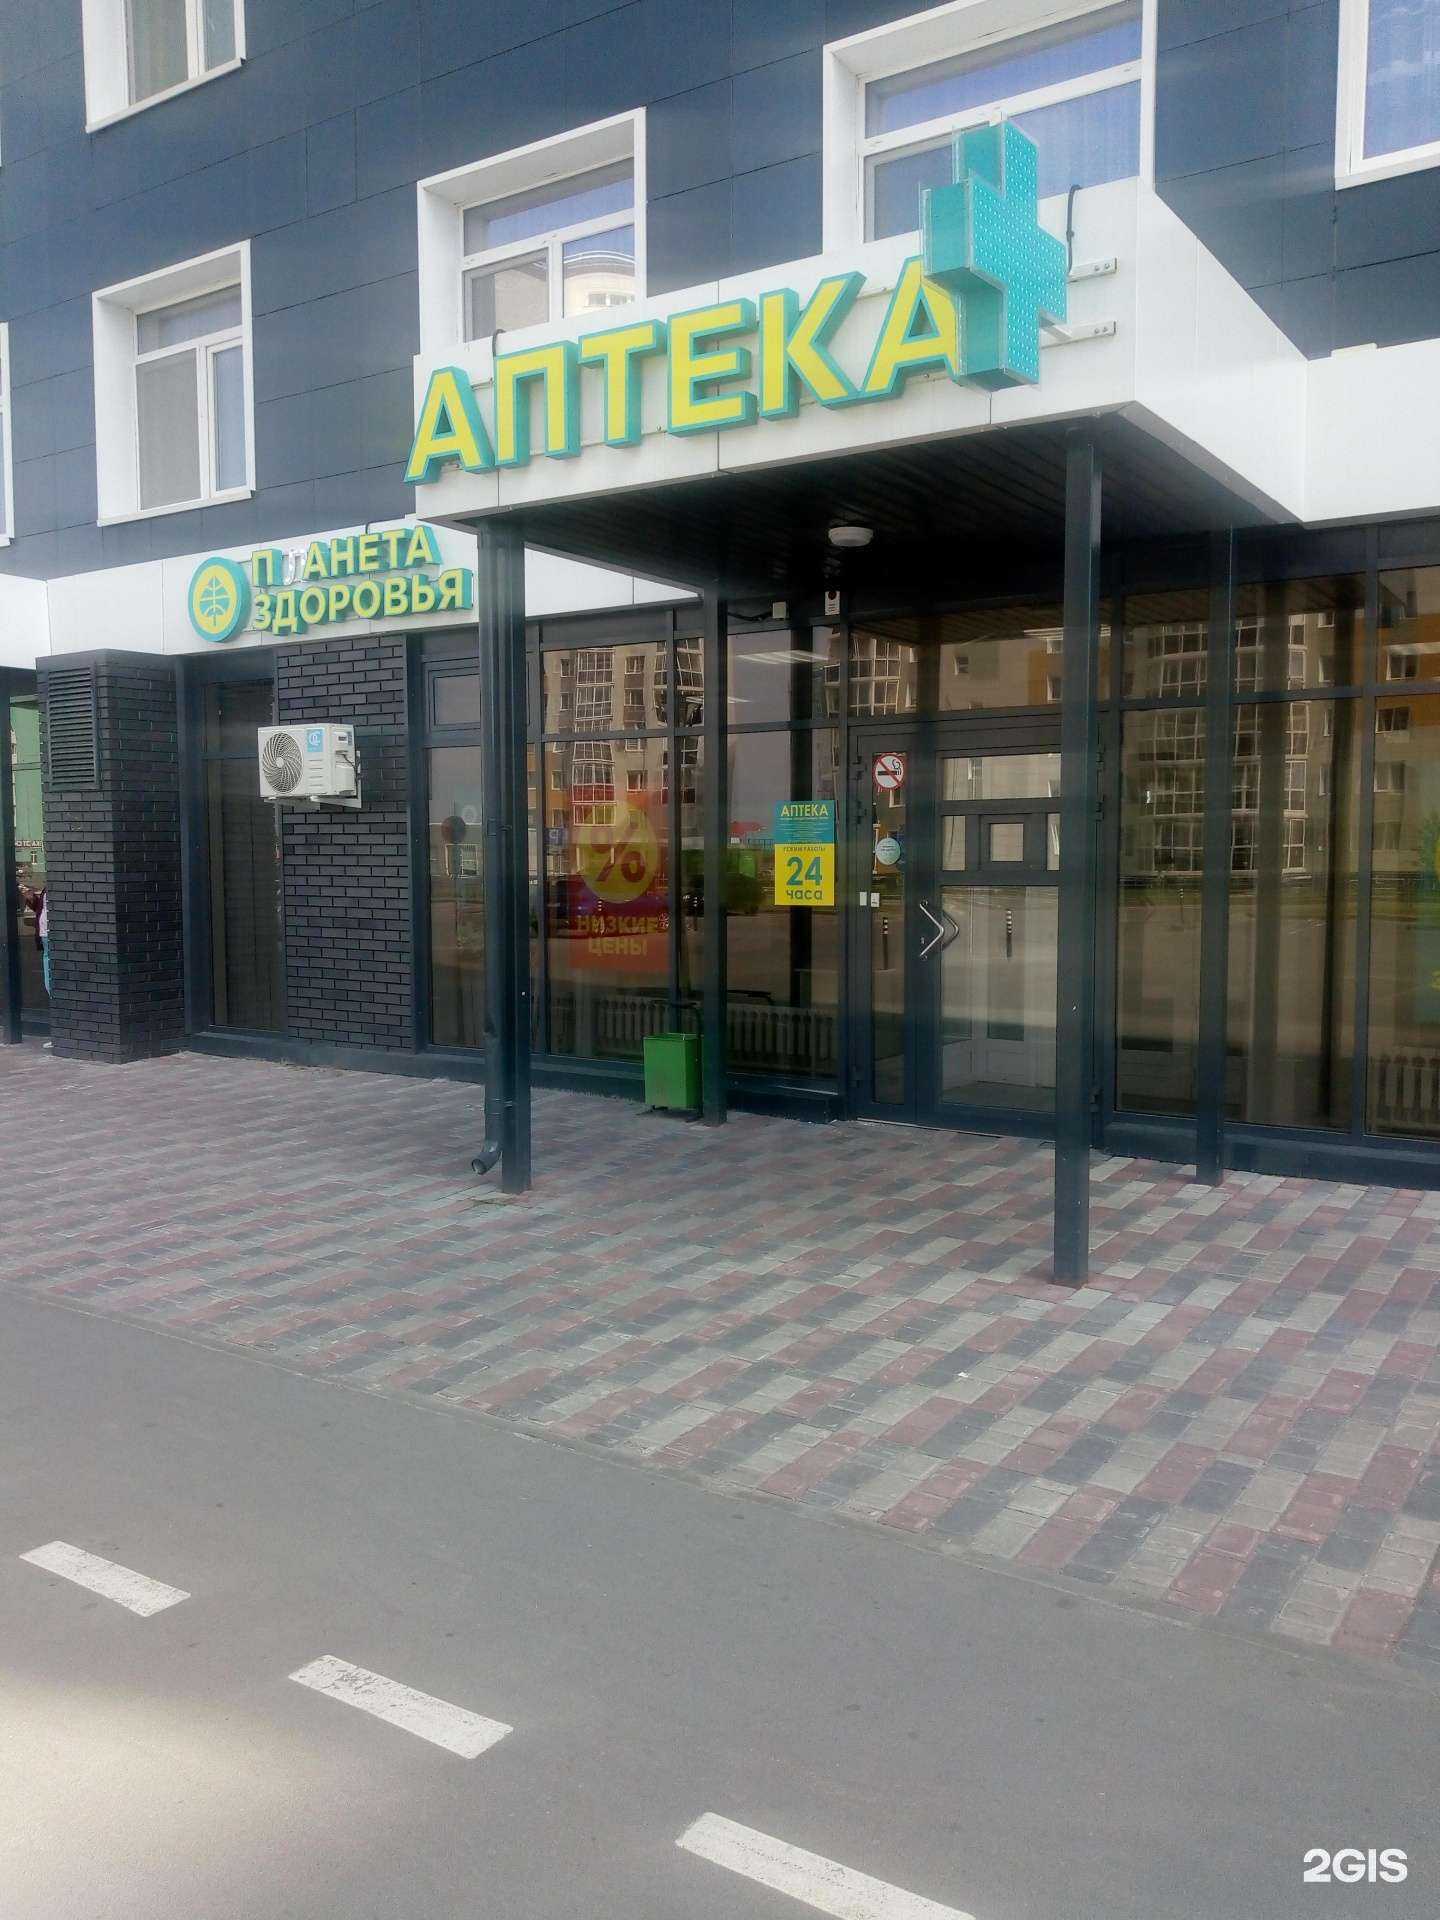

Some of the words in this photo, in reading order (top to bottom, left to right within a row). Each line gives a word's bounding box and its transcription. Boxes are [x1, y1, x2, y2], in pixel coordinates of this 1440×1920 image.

[403, 256, 957, 484] АПТЕКА
[252, 525, 441, 586] ПЛАНЕТА
[253, 568, 472, 635] ЗДОРОВЬЯ
[780, 804, 829, 817] АПТЕКА
[786, 856, 823, 886] 24
[786, 889, 823, 900] часа
